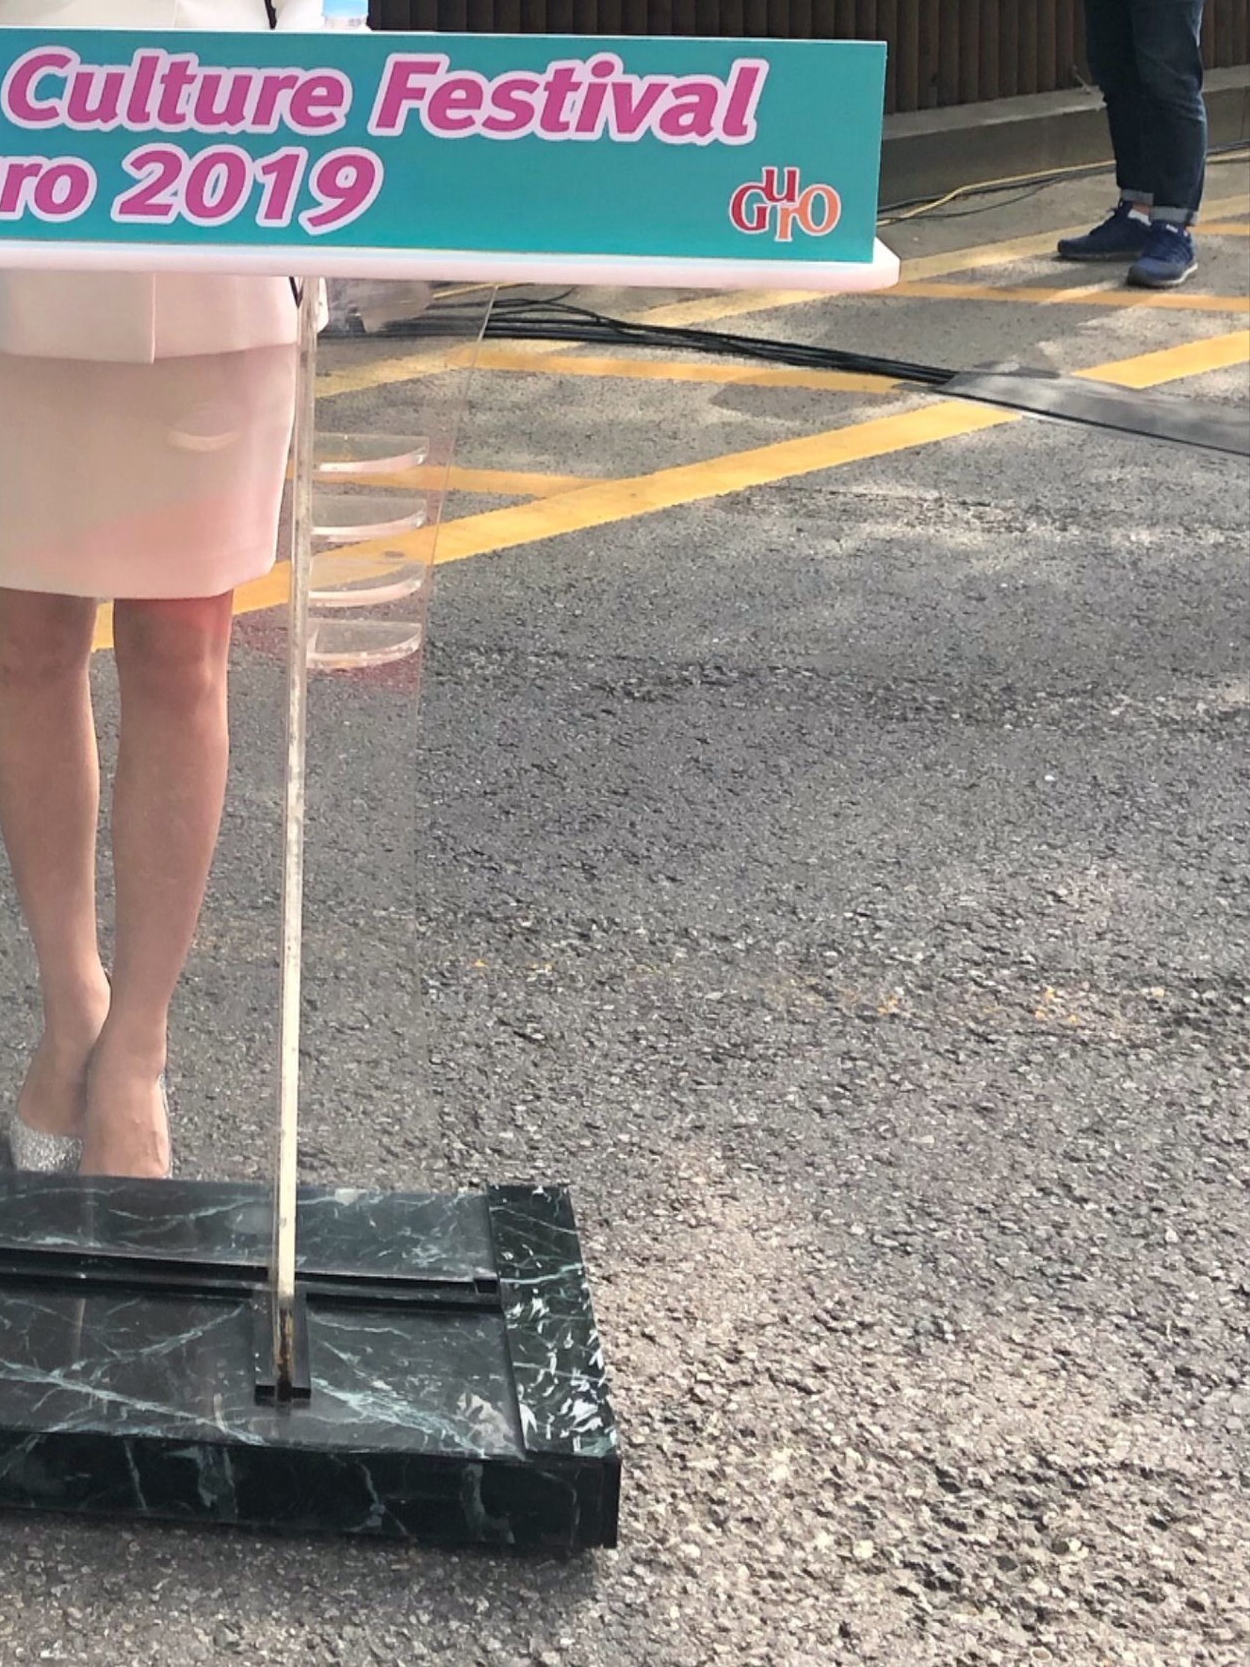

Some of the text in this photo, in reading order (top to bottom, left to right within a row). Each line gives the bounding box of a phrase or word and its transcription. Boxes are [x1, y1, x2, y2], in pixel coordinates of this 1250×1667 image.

[3, 49, 350, 132] Culture
[371, 56, 765, 142] Festival
[115, 145, 380, 232] 2019
